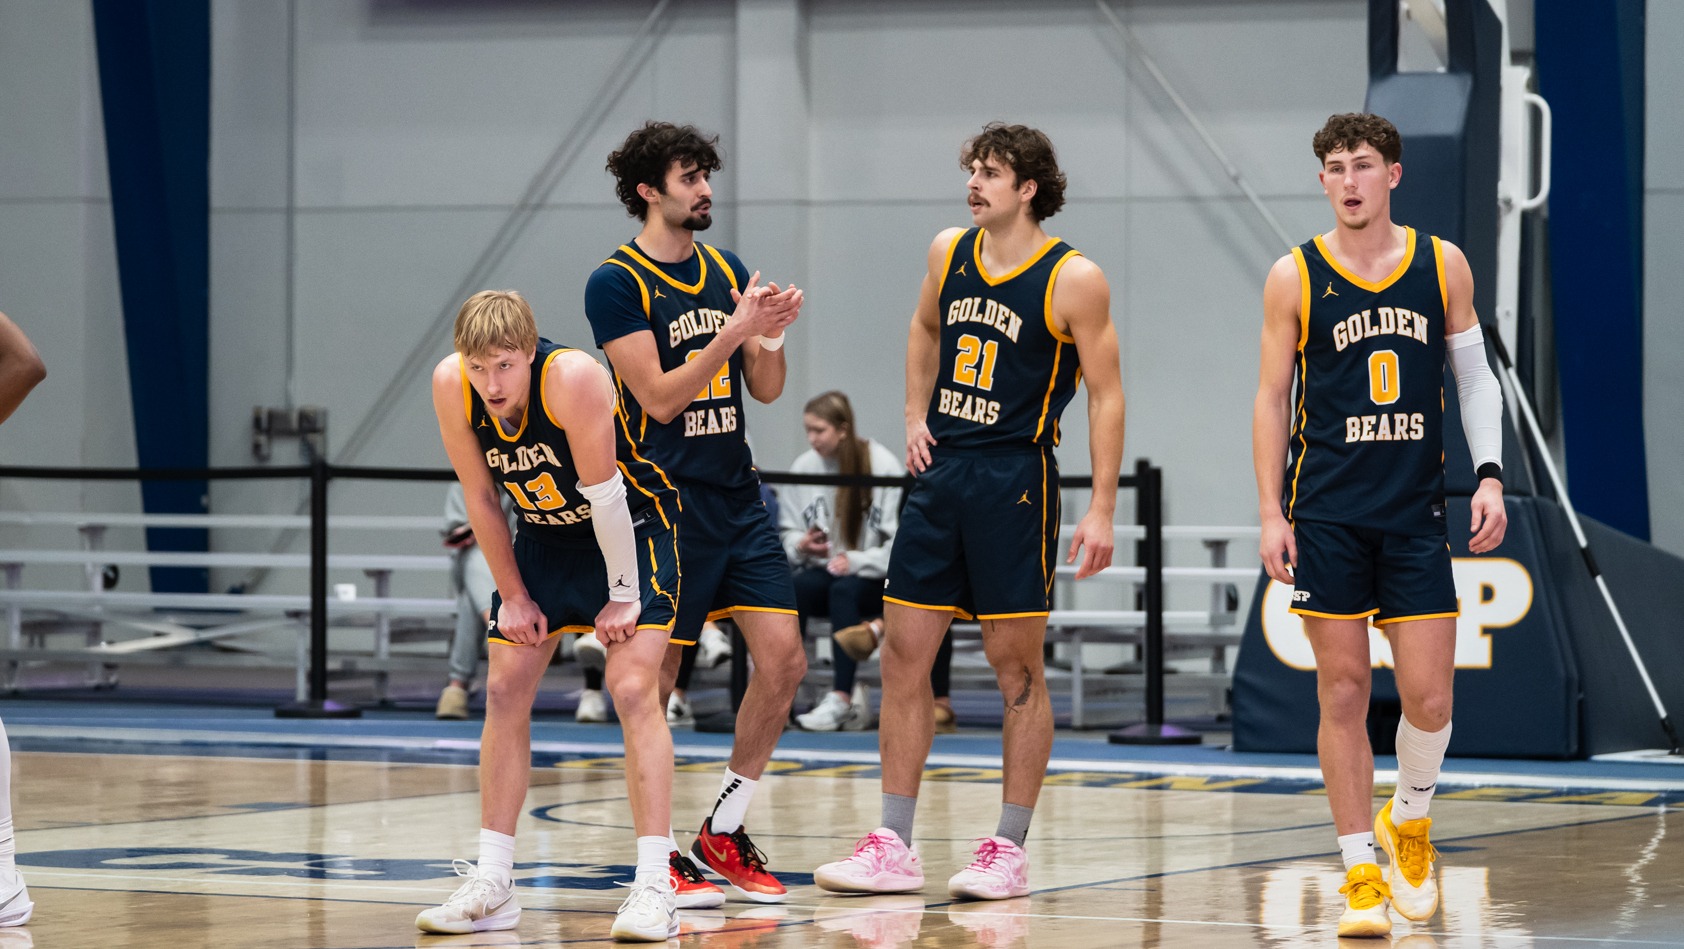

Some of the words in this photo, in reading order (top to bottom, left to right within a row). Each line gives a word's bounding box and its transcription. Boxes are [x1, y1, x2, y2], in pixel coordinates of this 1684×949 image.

[668, 308, 732, 349] GOLDE
[946, 296, 1023, 344] GOLDEN
[1332, 306, 1429, 352] GOLDEN
[952, 333, 999, 391] 21
[1368, 349, 1400, 405] 0
[684, 406, 737, 437] BEARS
[938, 387, 1001, 425] BEARS
[1345, 412, 1425, 443] BEARS
[485, 442, 563, 474] GLDEN
[503, 471, 567, 511] 13
[523, 503, 592, 526] EARS
[1261, 556, 1534, 671] CP
[1292, 590, 1311, 602] SP
